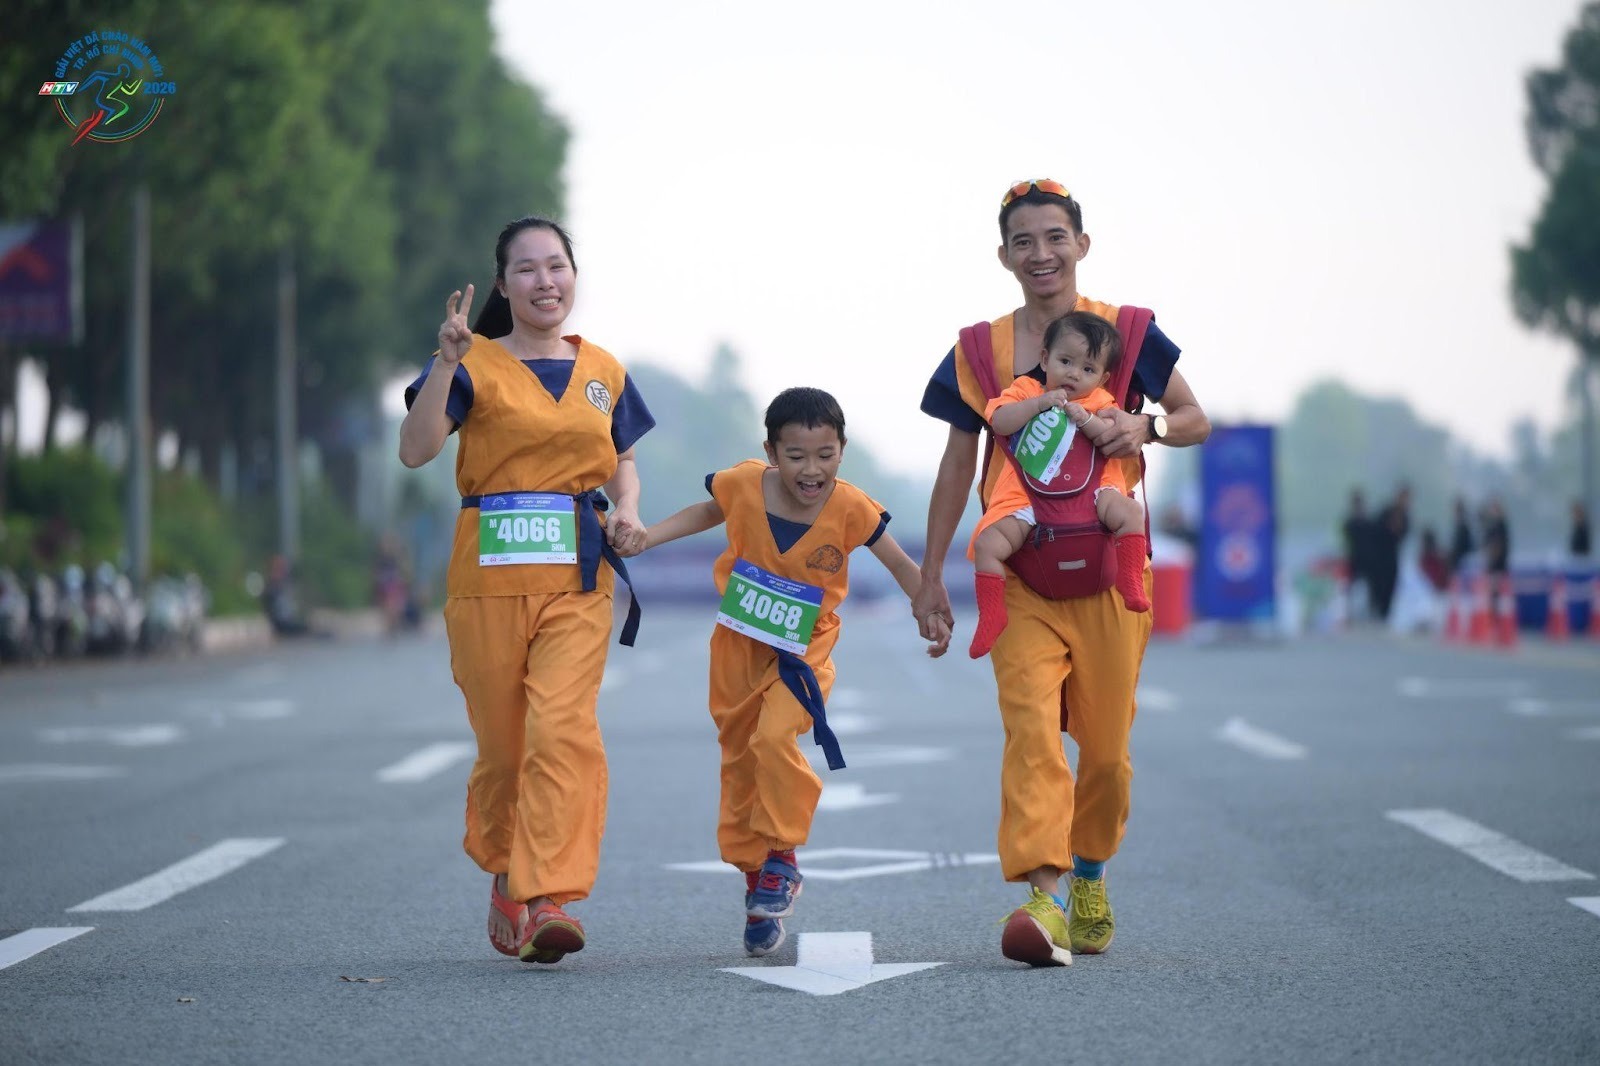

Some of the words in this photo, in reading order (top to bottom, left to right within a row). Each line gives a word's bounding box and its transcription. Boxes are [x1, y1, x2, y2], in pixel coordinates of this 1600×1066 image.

[1025, 406, 1061, 456] 406
[497, 516, 561, 543] 4066
[551, 543, 566, 552] 5KM
[739, 588, 803, 631] 4068
[785, 630, 800, 641] 5KM
